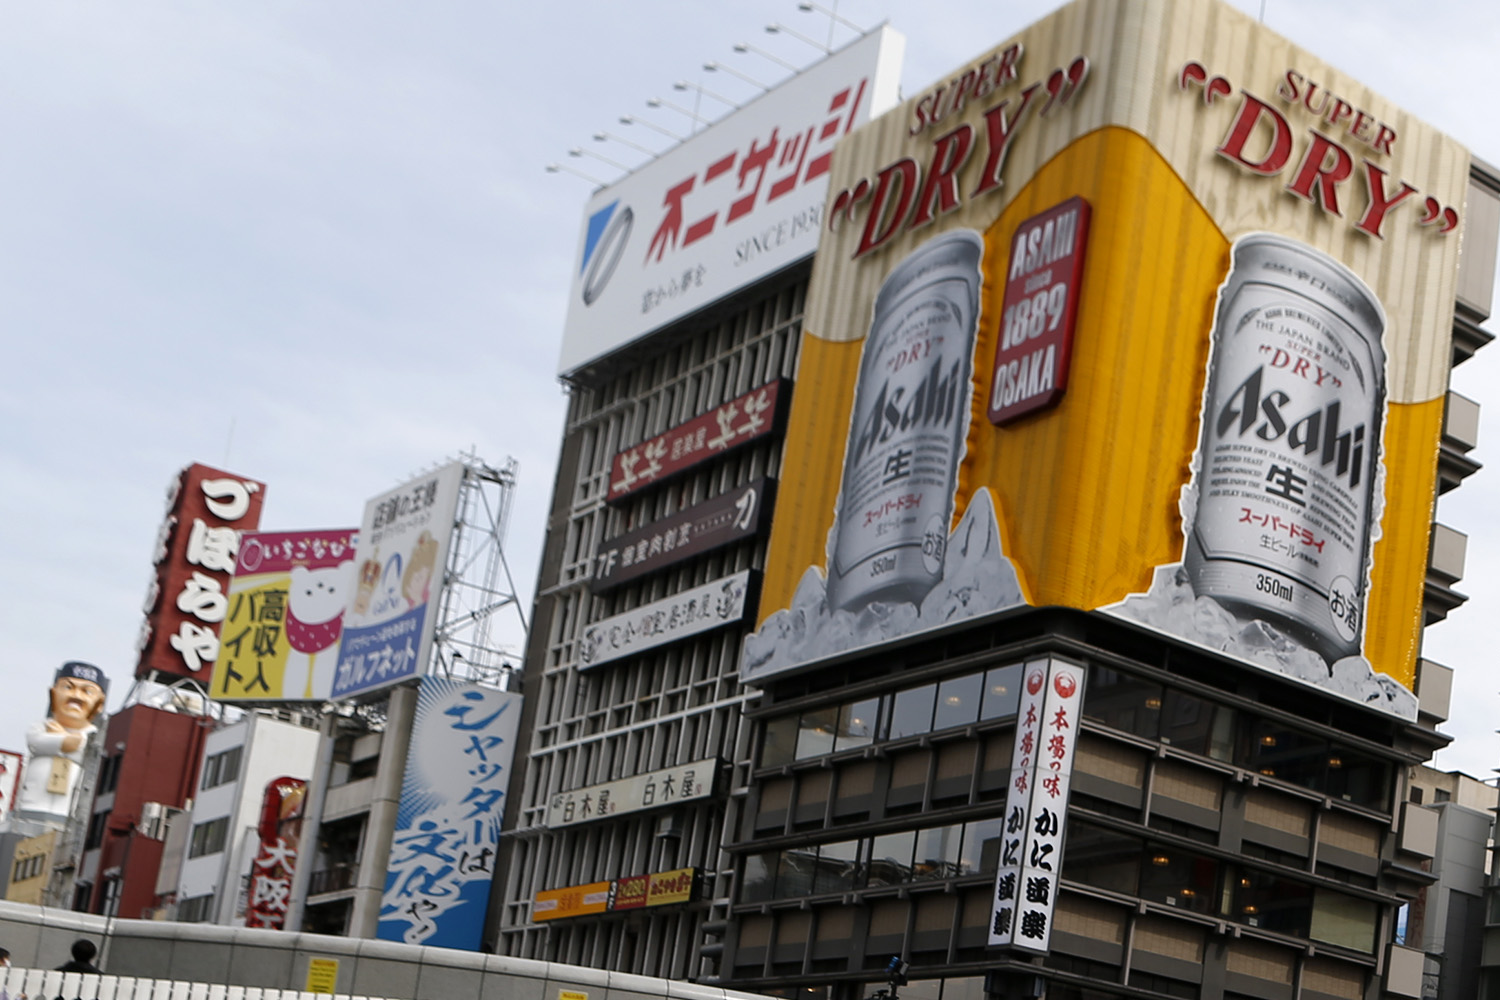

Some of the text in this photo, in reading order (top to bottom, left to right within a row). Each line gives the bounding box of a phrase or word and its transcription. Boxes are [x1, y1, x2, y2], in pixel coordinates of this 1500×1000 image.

[909, 42, 1025, 138] SUPER
[1279, 68, 1399, 157] SUPER
[734, 220, 788, 267] SINCE
[1010, 209, 1078, 282] ASAHI
[1001, 282, 1067, 352] 1889
[1279, 327, 1314, 346] JAPAN
[991, 344, 1056, 412] OSAKA
[854, 354, 961, 468] Asahi
[1216, 363, 1366, 490] Asahi
[882, 449, 912, 486] 生
[1265, 463, 1308, 508] 生
[862, 493, 923, 528] スーパードライ
[1239, 507, 1326, 554] スーパードライ
[1256, 574, 1293, 602] 350ml
[1331, 588, 1359, 634] お酒
[244, 588, 288, 693] 高収入
[643, 771, 695, 806] 白木屋
[1021, 808, 1059, 940] かに道楽
